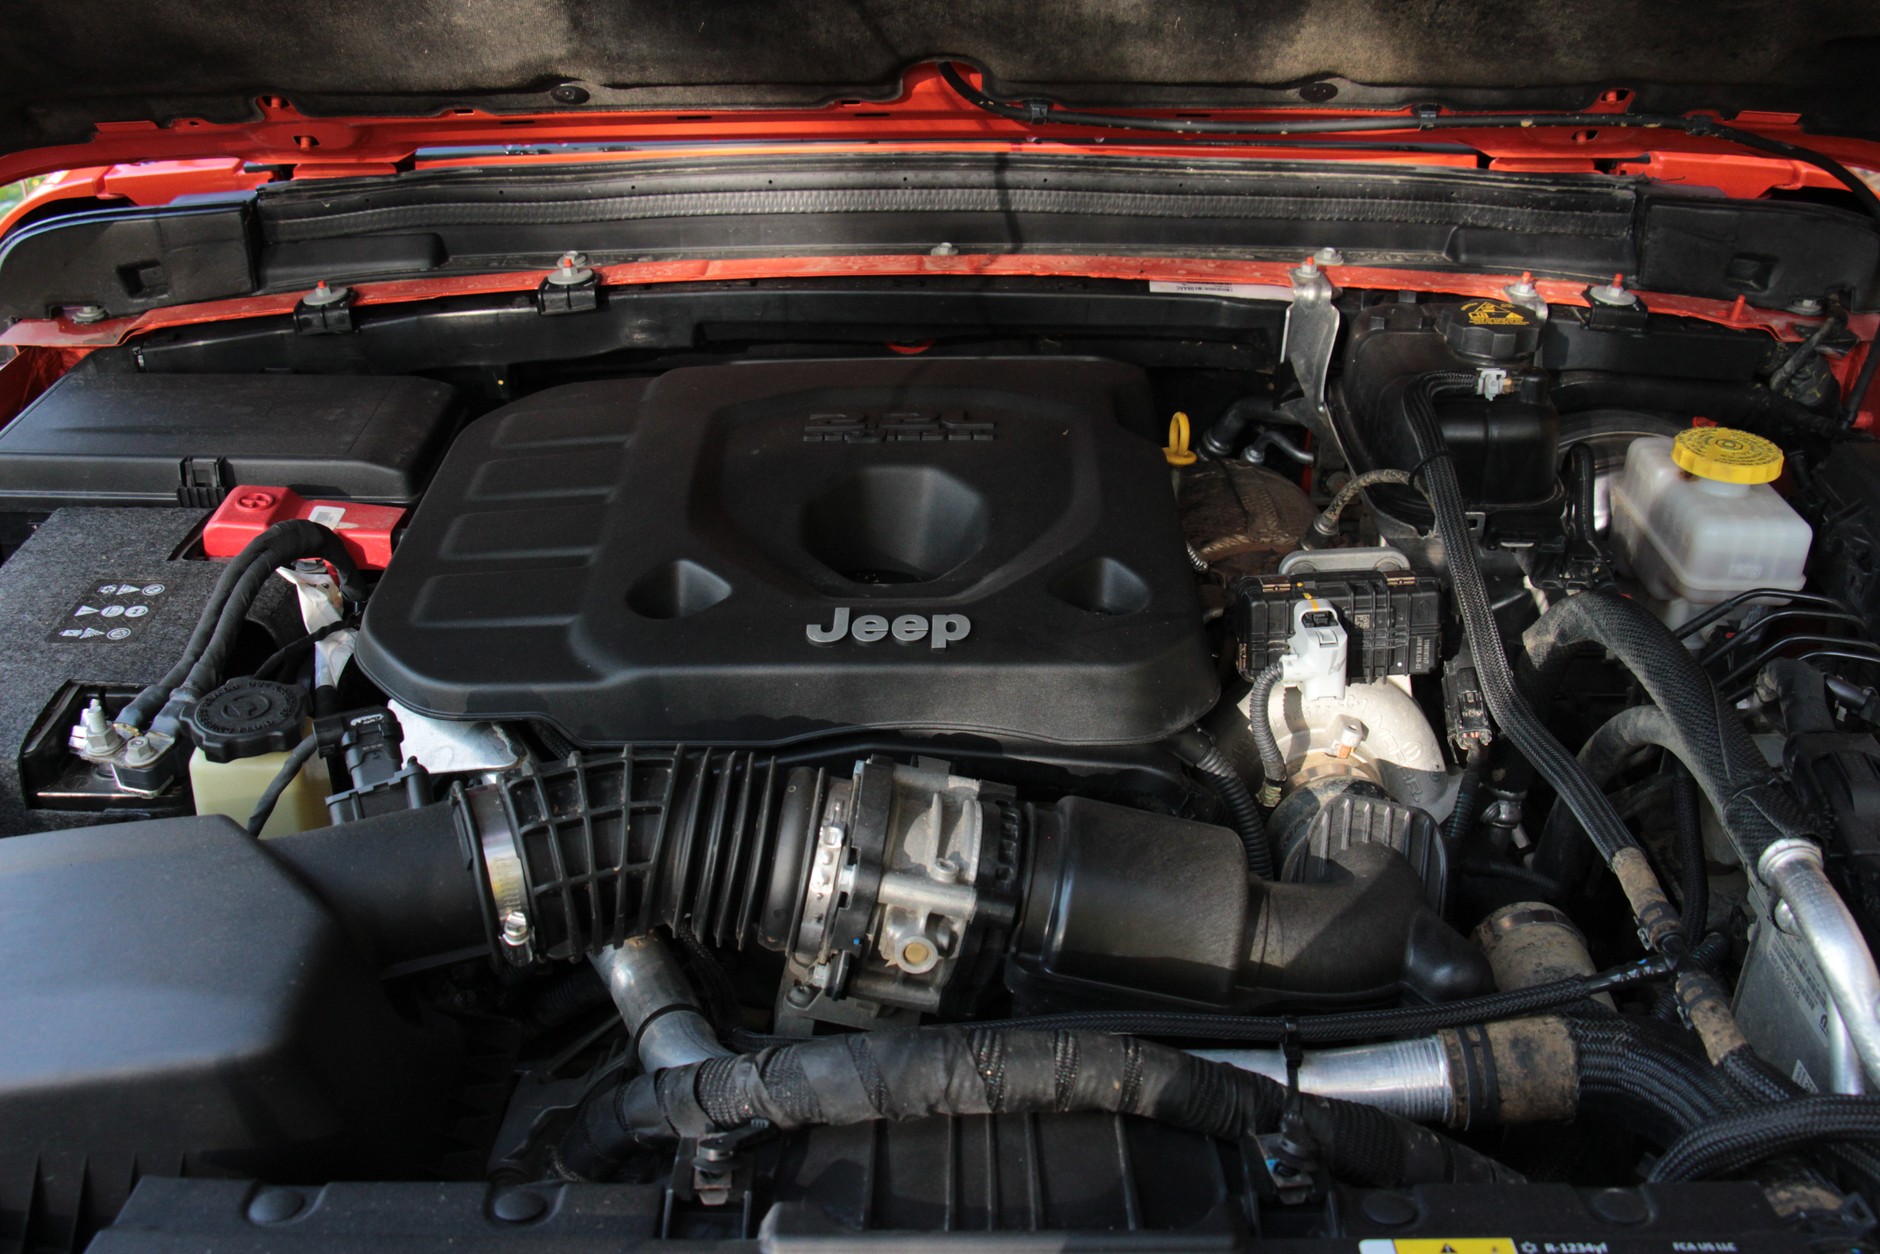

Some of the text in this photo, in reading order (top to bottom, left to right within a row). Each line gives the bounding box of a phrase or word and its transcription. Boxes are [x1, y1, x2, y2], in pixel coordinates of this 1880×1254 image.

[806, 607, 971, 649] Jeep
[1672, 1241, 1738, 1252] FCA US LLC
